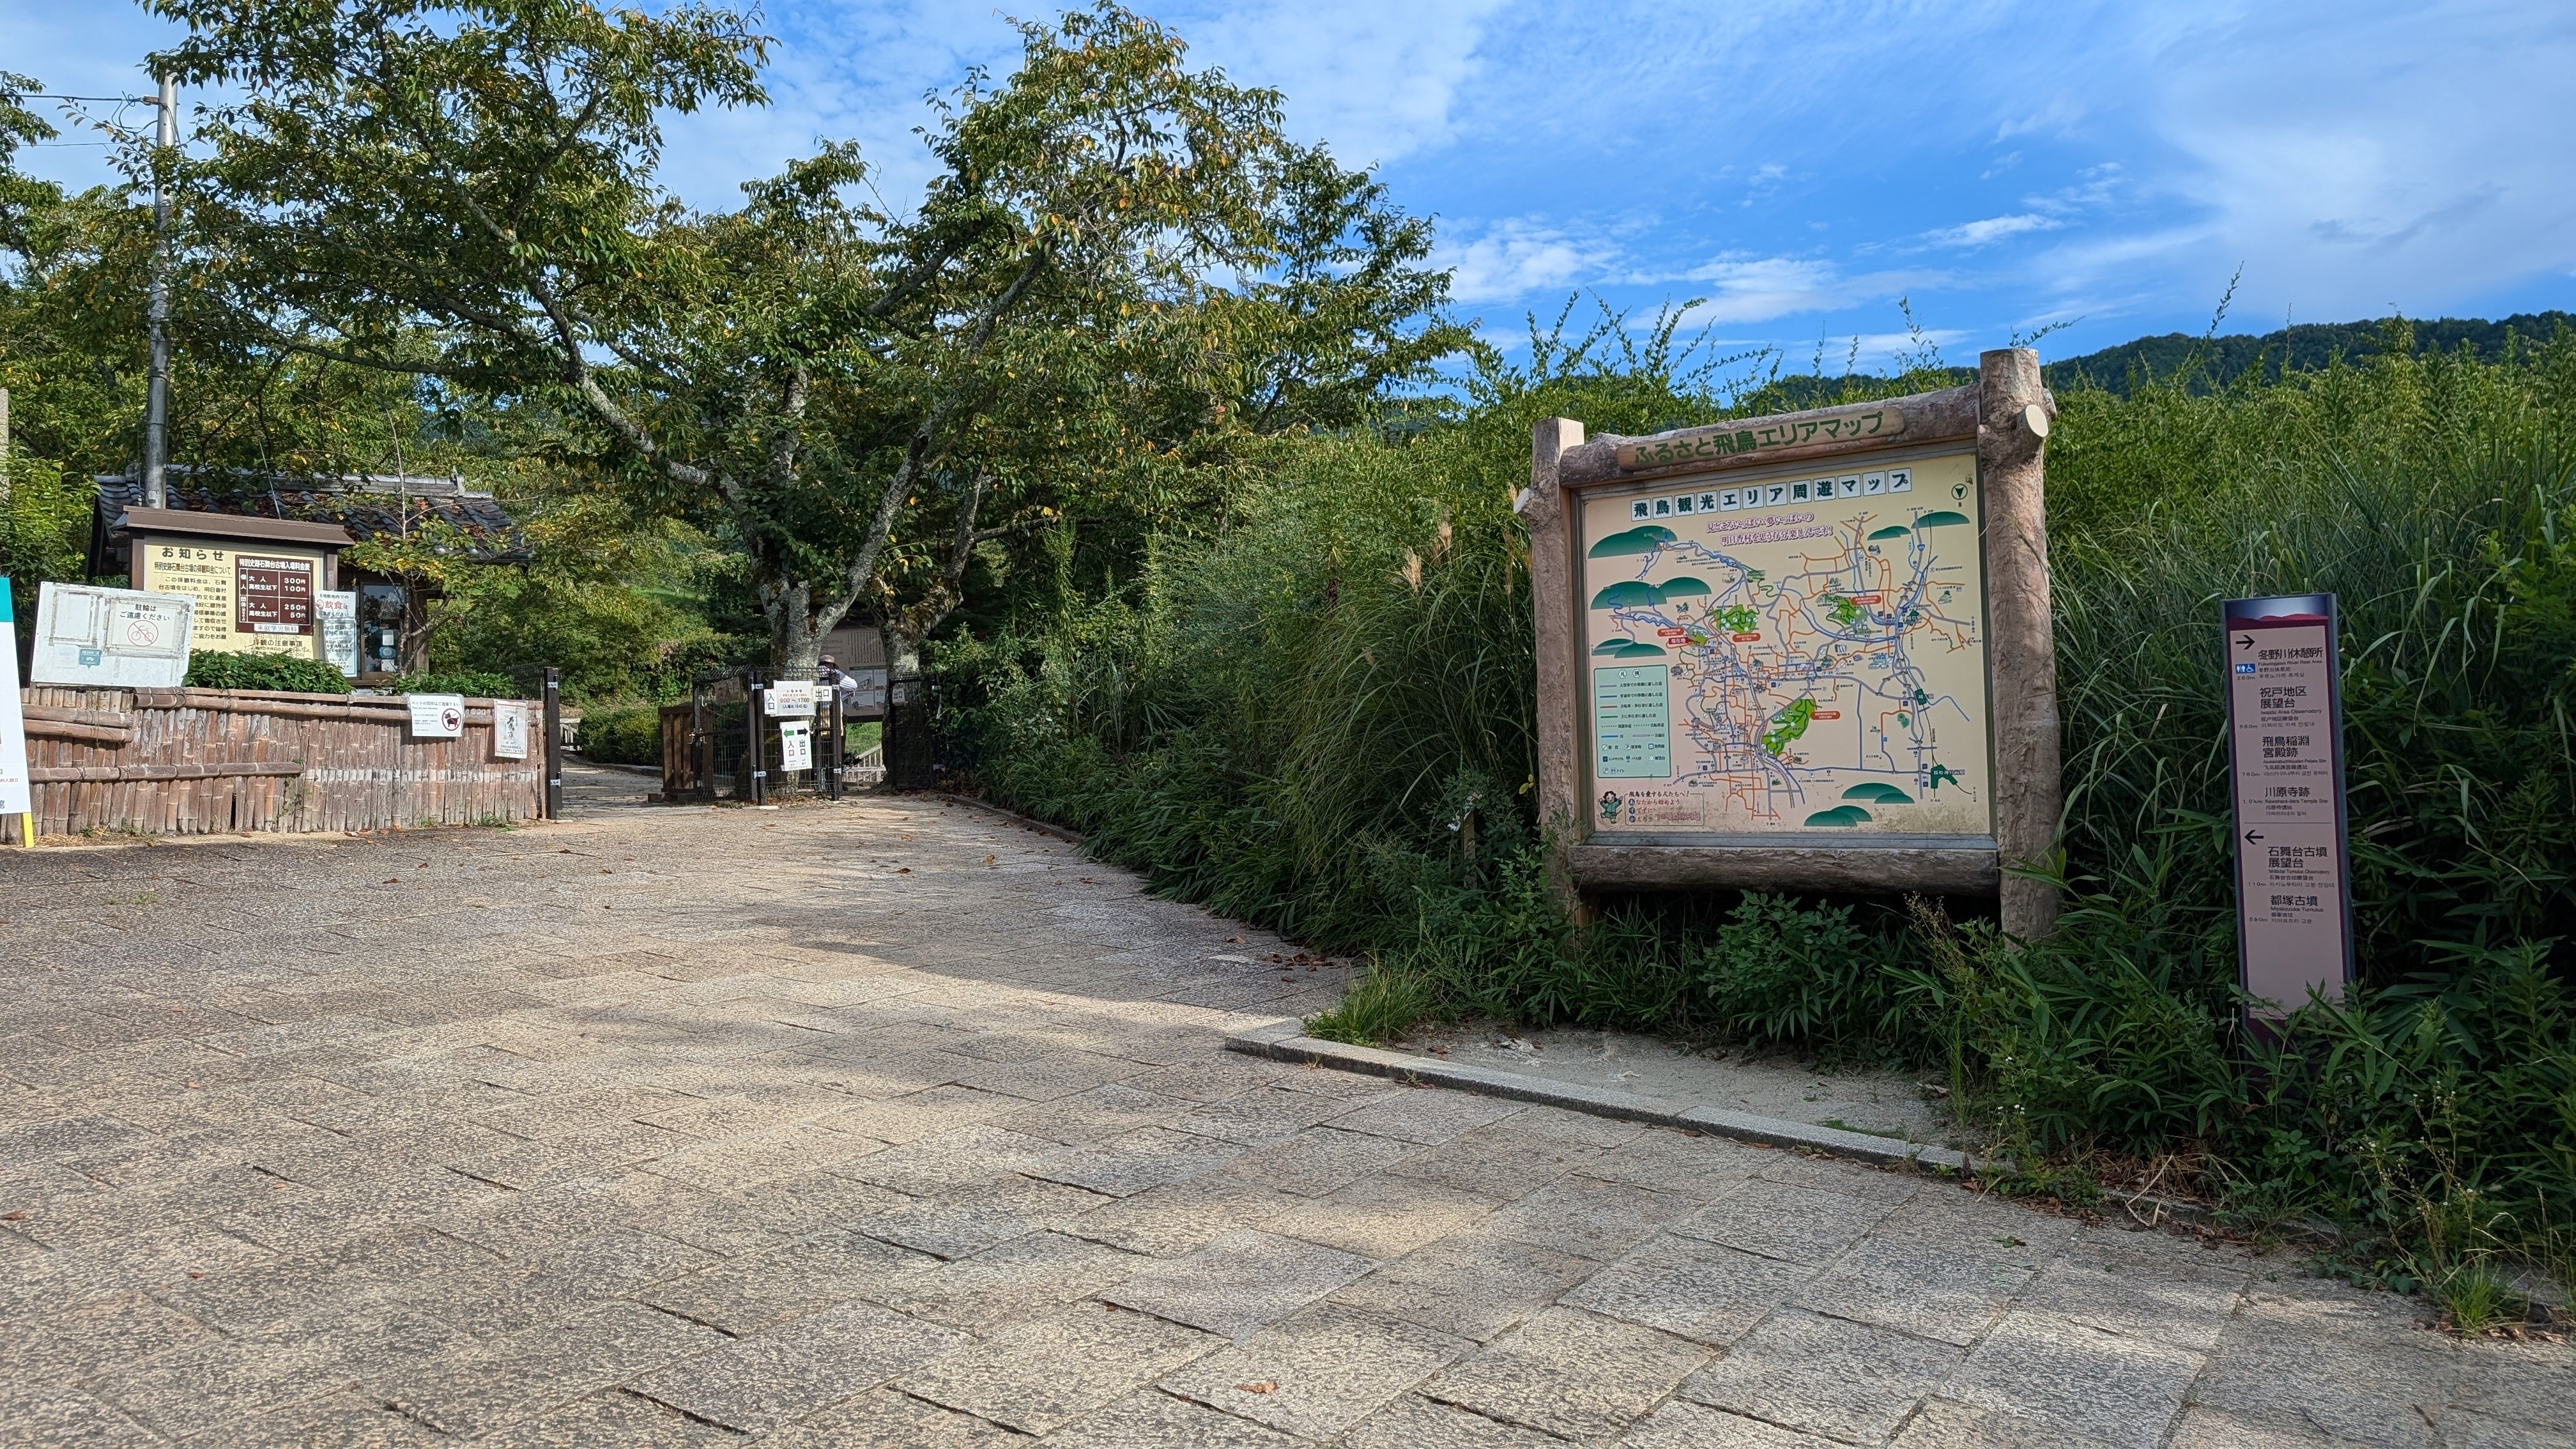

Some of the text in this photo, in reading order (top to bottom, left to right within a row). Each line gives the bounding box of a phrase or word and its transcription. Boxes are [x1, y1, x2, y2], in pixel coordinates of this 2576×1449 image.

[1634, 411, 1883, 465] ふるさと飛鳥エリアマップ
[1634, 472, 1909, 518] 飛鳥観光エリア周遊マップ
[162, 547, 224, 561] お知らせ
[241, 574, 246, 589] 個人
[135, 604, 157, 612] 駐輪は
[325, 601, 348, 610] 飲食は
[119, 611, 170, 621] ご遠慮ください
[2258, 647, 2323, 661] 冬野川休憩所
[815, 687, 829, 698] 出口
[2260, 686, 2307, 698] 祝戸地区
[767, 693, 775, 710] 入口
[2260, 698, 2296, 709] 展望台
[2262, 735, 2310, 747] 飛鳥稲淵
[788, 740, 795, 756] 入口
[799, 739, 806, 756] 出口
[2262, 747, 2298, 758] 宮殿跡
[2265, 786, 2310, 798] 川原寺跡
[2267, 846, 2328, 857] 石舞台古墳
[2269, 857, 2304, 868] 展望台
[2271, 895, 2318, 907] 都塚古墳
